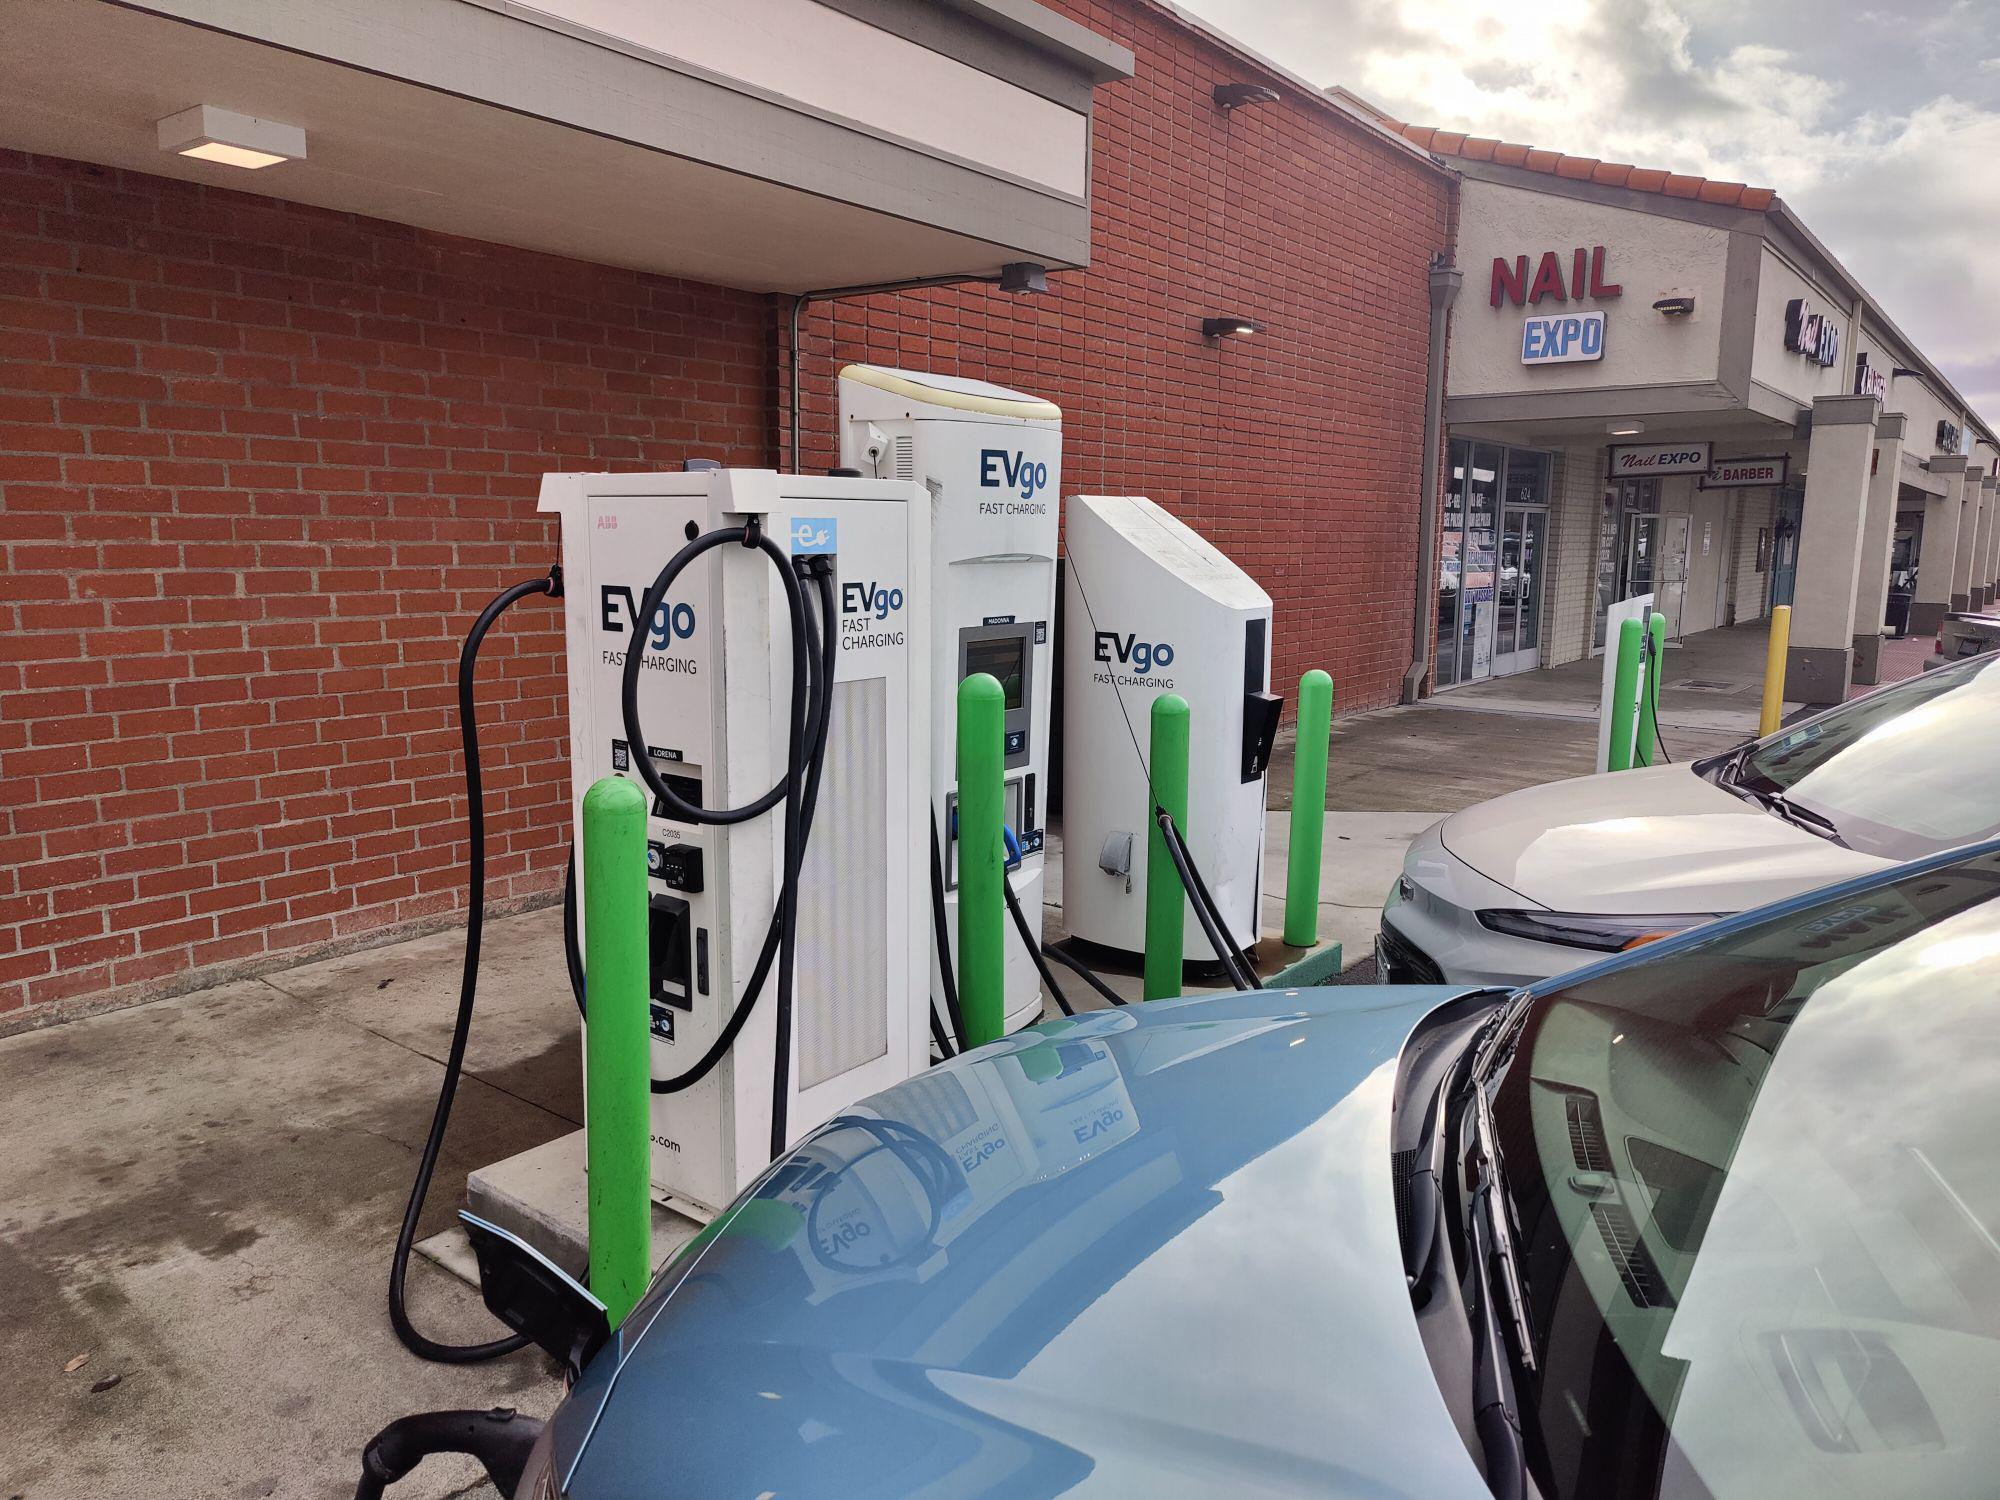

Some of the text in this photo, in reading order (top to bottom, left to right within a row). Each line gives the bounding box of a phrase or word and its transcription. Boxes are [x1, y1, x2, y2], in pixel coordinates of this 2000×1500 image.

[1490, 246, 1623, 308] NAIL
[1523, 318, 1602, 359] EXPO
[1620, 452, 1702, 467] Nail EXPO
[980, 449, 1047, 499] EVgo
[1723, 467, 1774, 481] BARBER
[979, 503, 1046, 515] FAST CHARGING
[597, 515, 618, 529] ABB
[842, 582, 904, 620] EVgo
[842, 618, 871, 633] FAST
[987, 617, 1010, 625] MADONNA
[842, 632, 904, 651] CHARGING
[1094, 631, 1175, 674] EVgo
[641, 655, 697, 674] HARGING
[1093, 673, 1174, 689] FAST CHARGING
[653, 749, 677, 759] LORENA
[662, 828, 681, 840] C2035
